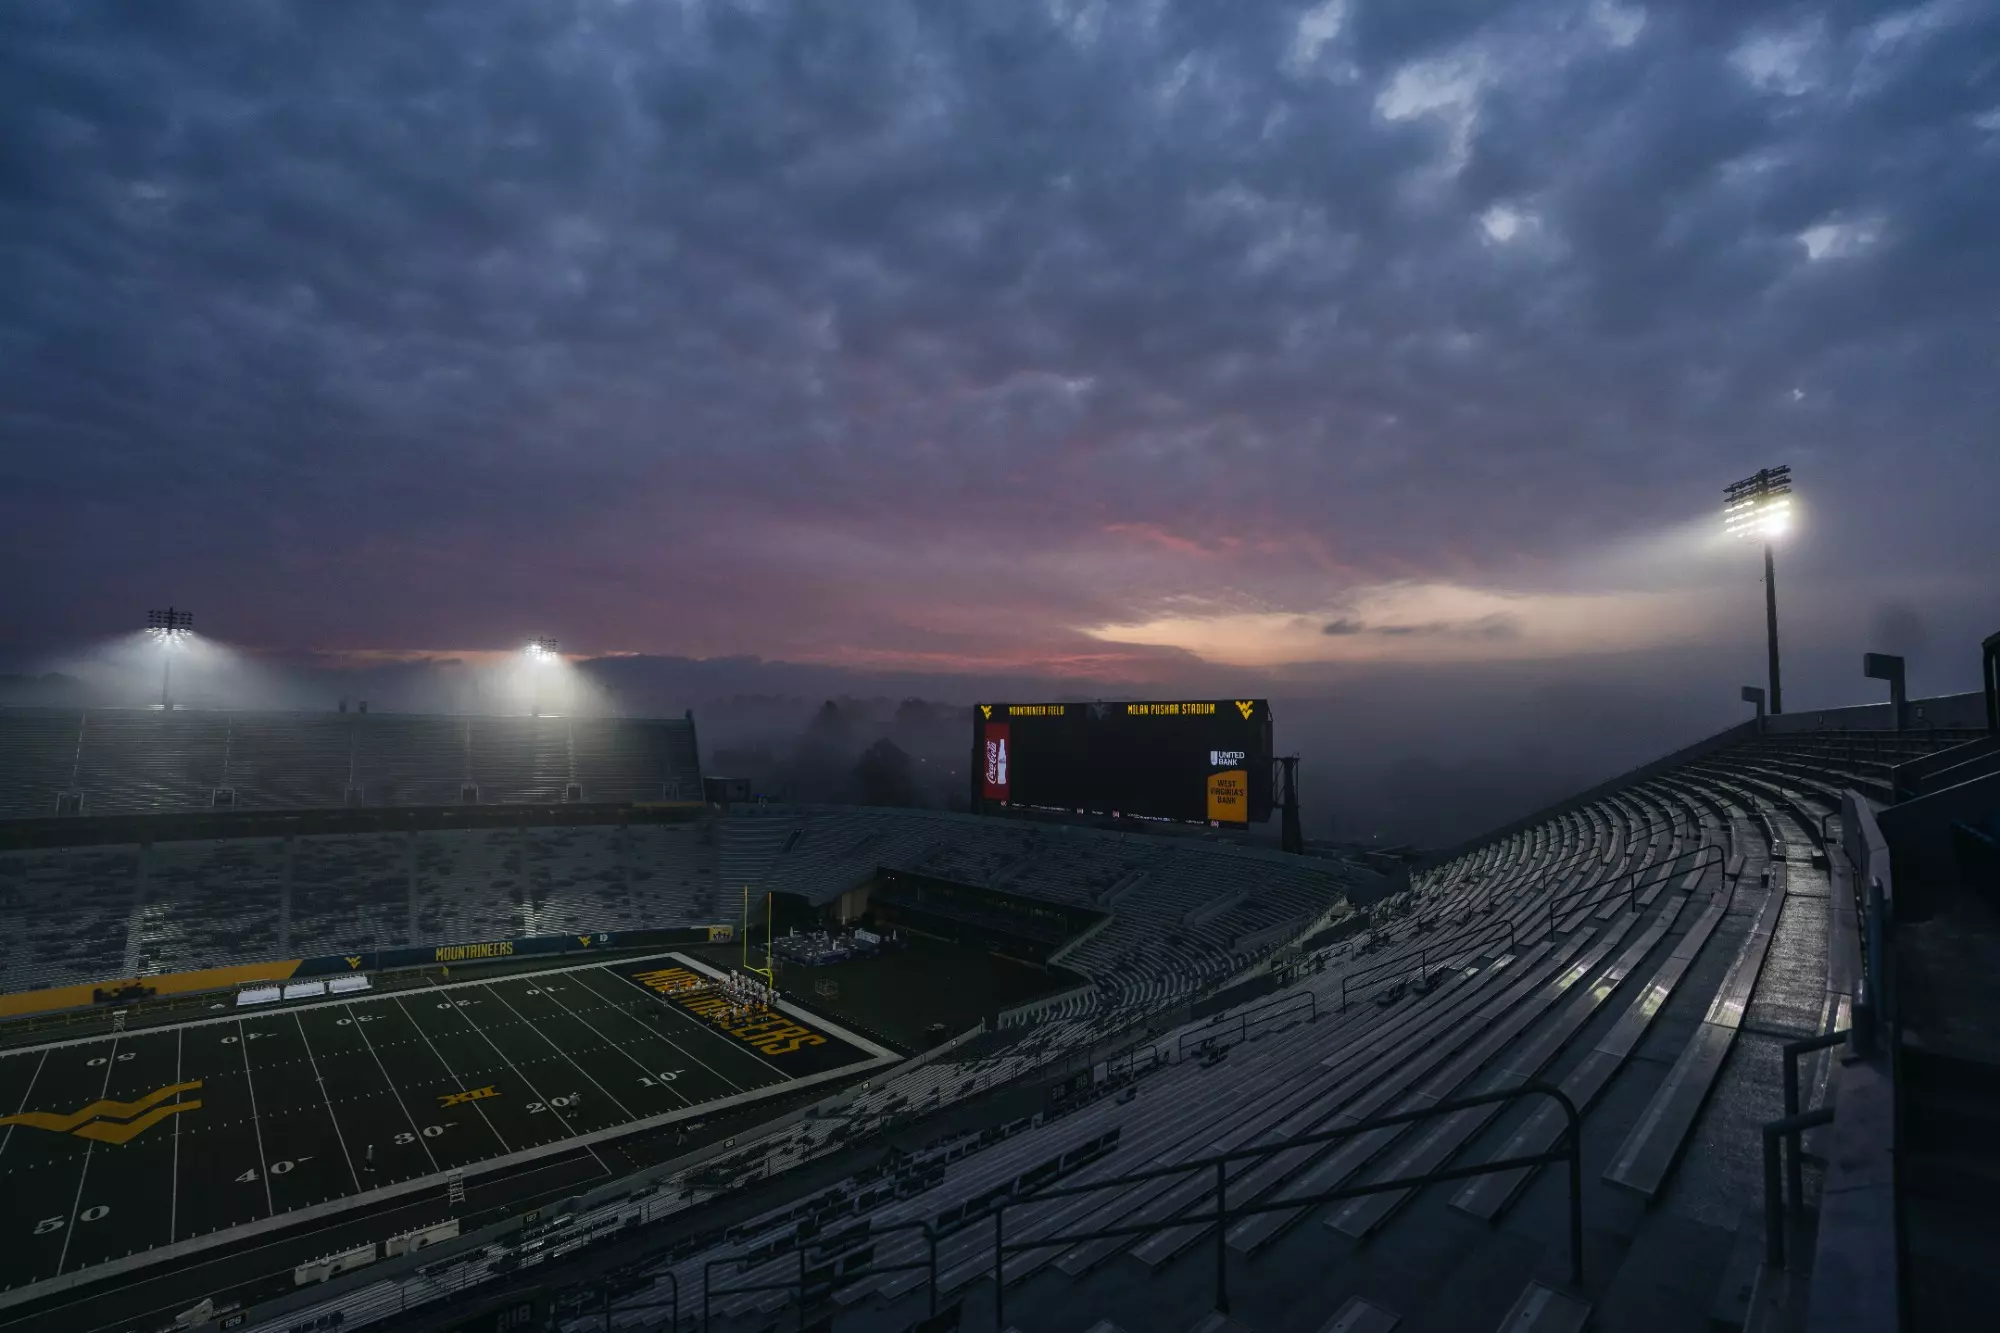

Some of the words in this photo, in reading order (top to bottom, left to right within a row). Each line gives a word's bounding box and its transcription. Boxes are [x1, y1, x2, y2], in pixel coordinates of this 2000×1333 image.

[1048, 704, 1065, 716] FIELD
[1127, 704, 1149, 715] MILAN
[1150, 703, 1179, 715] PUSKAR
[1181, 703, 1216, 715] STADIUM
[1219, 751, 1245, 759] UNITED
[1217, 780, 1237, 788] WEST
[1210, 788, 1244, 797] VIRGINIA'S
[1217, 796, 1237, 804] BANK
[435, 941, 513, 961] MOUNTAINEERS
[630, 967, 829, 1055] MOUTAIERS
[637, 1070, 676, 1088] 10
[526, 1096, 570, 1114] 20
[393, 1125, 444, 1145] 30
[234, 1160, 294, 1183] 40
[32, 1205, 110, 1235] 50
[225, 1316, 242, 1329] 126
